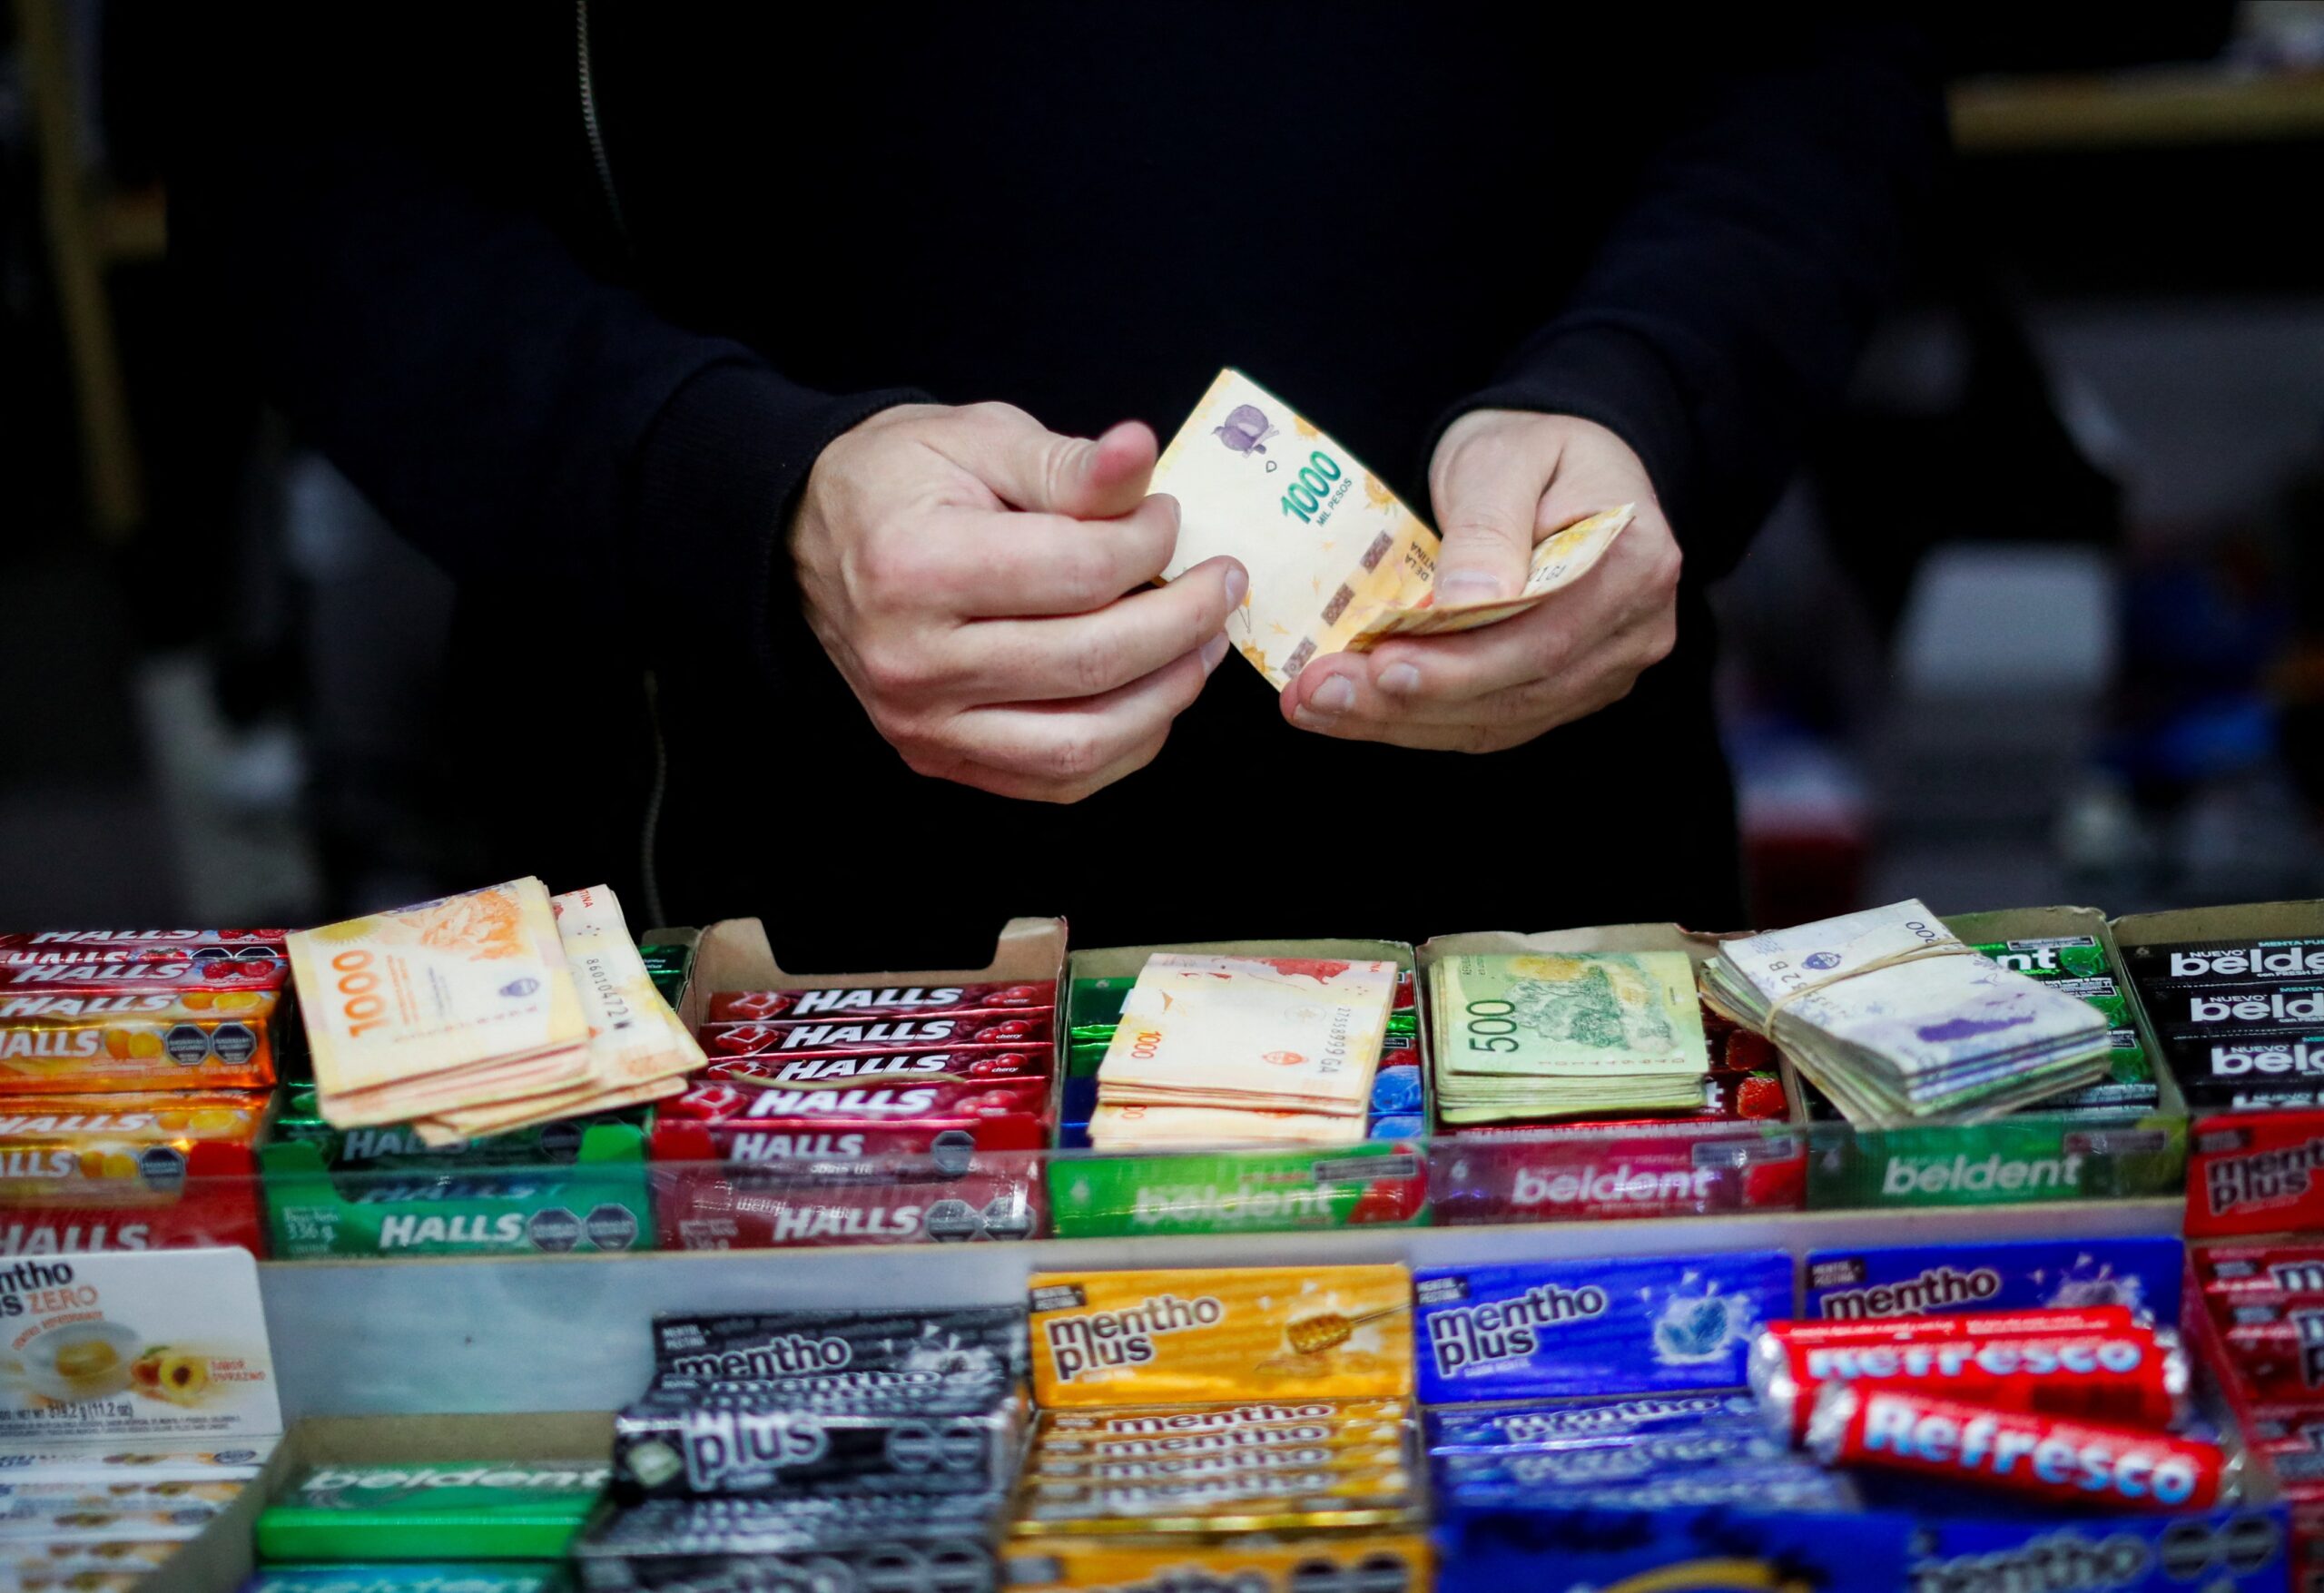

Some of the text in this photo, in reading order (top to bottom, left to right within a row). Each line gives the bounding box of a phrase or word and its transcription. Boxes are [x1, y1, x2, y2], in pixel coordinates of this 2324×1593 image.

[1281, 451, 1341, 525] 1000
[1316, 477, 1352, 526] MIL PESOS
[1404, 553, 1430, 582] DE LA
[2190, 949, 2245, 959] NUEVO
[10, 963, 192, 983] HALLS
[0, 995, 178, 1017] HALLS
[331, 949, 391, 1037] 1000
[792, 988, 964, 1016] HALLS
[2210, 994, 2267, 1003] NUEVO
[780, 1020, 956, 1049] HALLS
[1131, 1030, 1162, 1059] 1000
[1465, 999, 1520, 1053] 500
[774, 1054, 951, 1081] HALLS
[746, 1088, 939, 1117] HALLS
[0, 1152, 74, 1177] LLS
[731, 1132, 865, 1162] HALLS
[1512, 1165, 1714, 1205] beldent
[1882, 1154, 2083, 1195] beldent
[1134, 1183, 1333, 1223] beldent
[379, 1213, 526, 1248] HALLS
[773, 1205, 923, 1242] HALLS
[25, 1285, 99, 1315] ZERO
[1428, 1285, 1606, 1340] mentho
[1821, 1269, 1999, 1320] mentho
[1047, 1295, 1223, 1346] mentho
[675, 1335, 851, 1375] mentho
[1053, 1335, 1154, 1381] plus
[1435, 1328, 1536, 1376] plus
[1807, 1339, 2142, 1379] Refresco
[1109, 1405, 1336, 1433] mentho
[688, 1417, 823, 1487] plus
[1864, 1395, 2197, 1504] Refresco
[300, 1469, 611, 1491] beldent
